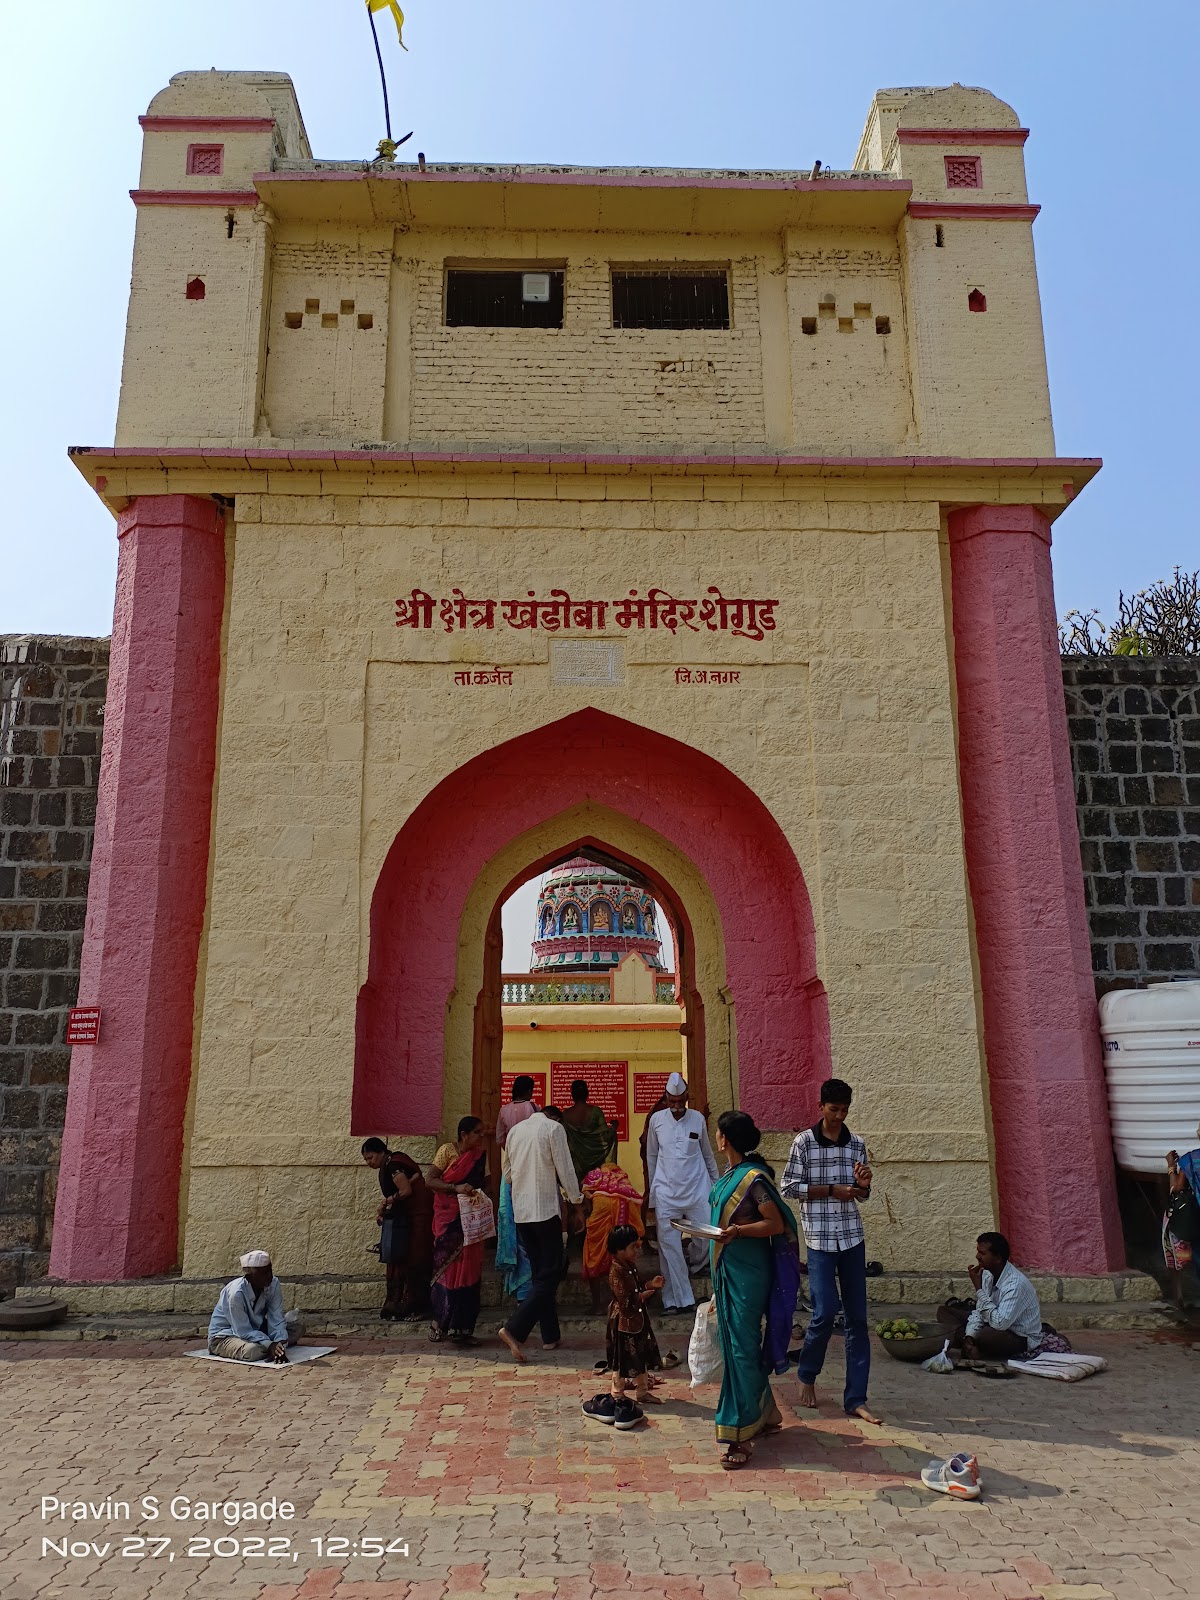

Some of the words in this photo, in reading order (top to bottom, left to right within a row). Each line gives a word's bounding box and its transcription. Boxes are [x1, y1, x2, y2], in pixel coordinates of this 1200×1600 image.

[395, 588, 437, 629] श्री
[440, 588, 497, 633] क्षेत्र
[501, 589, 608, 632] खंडोबा
